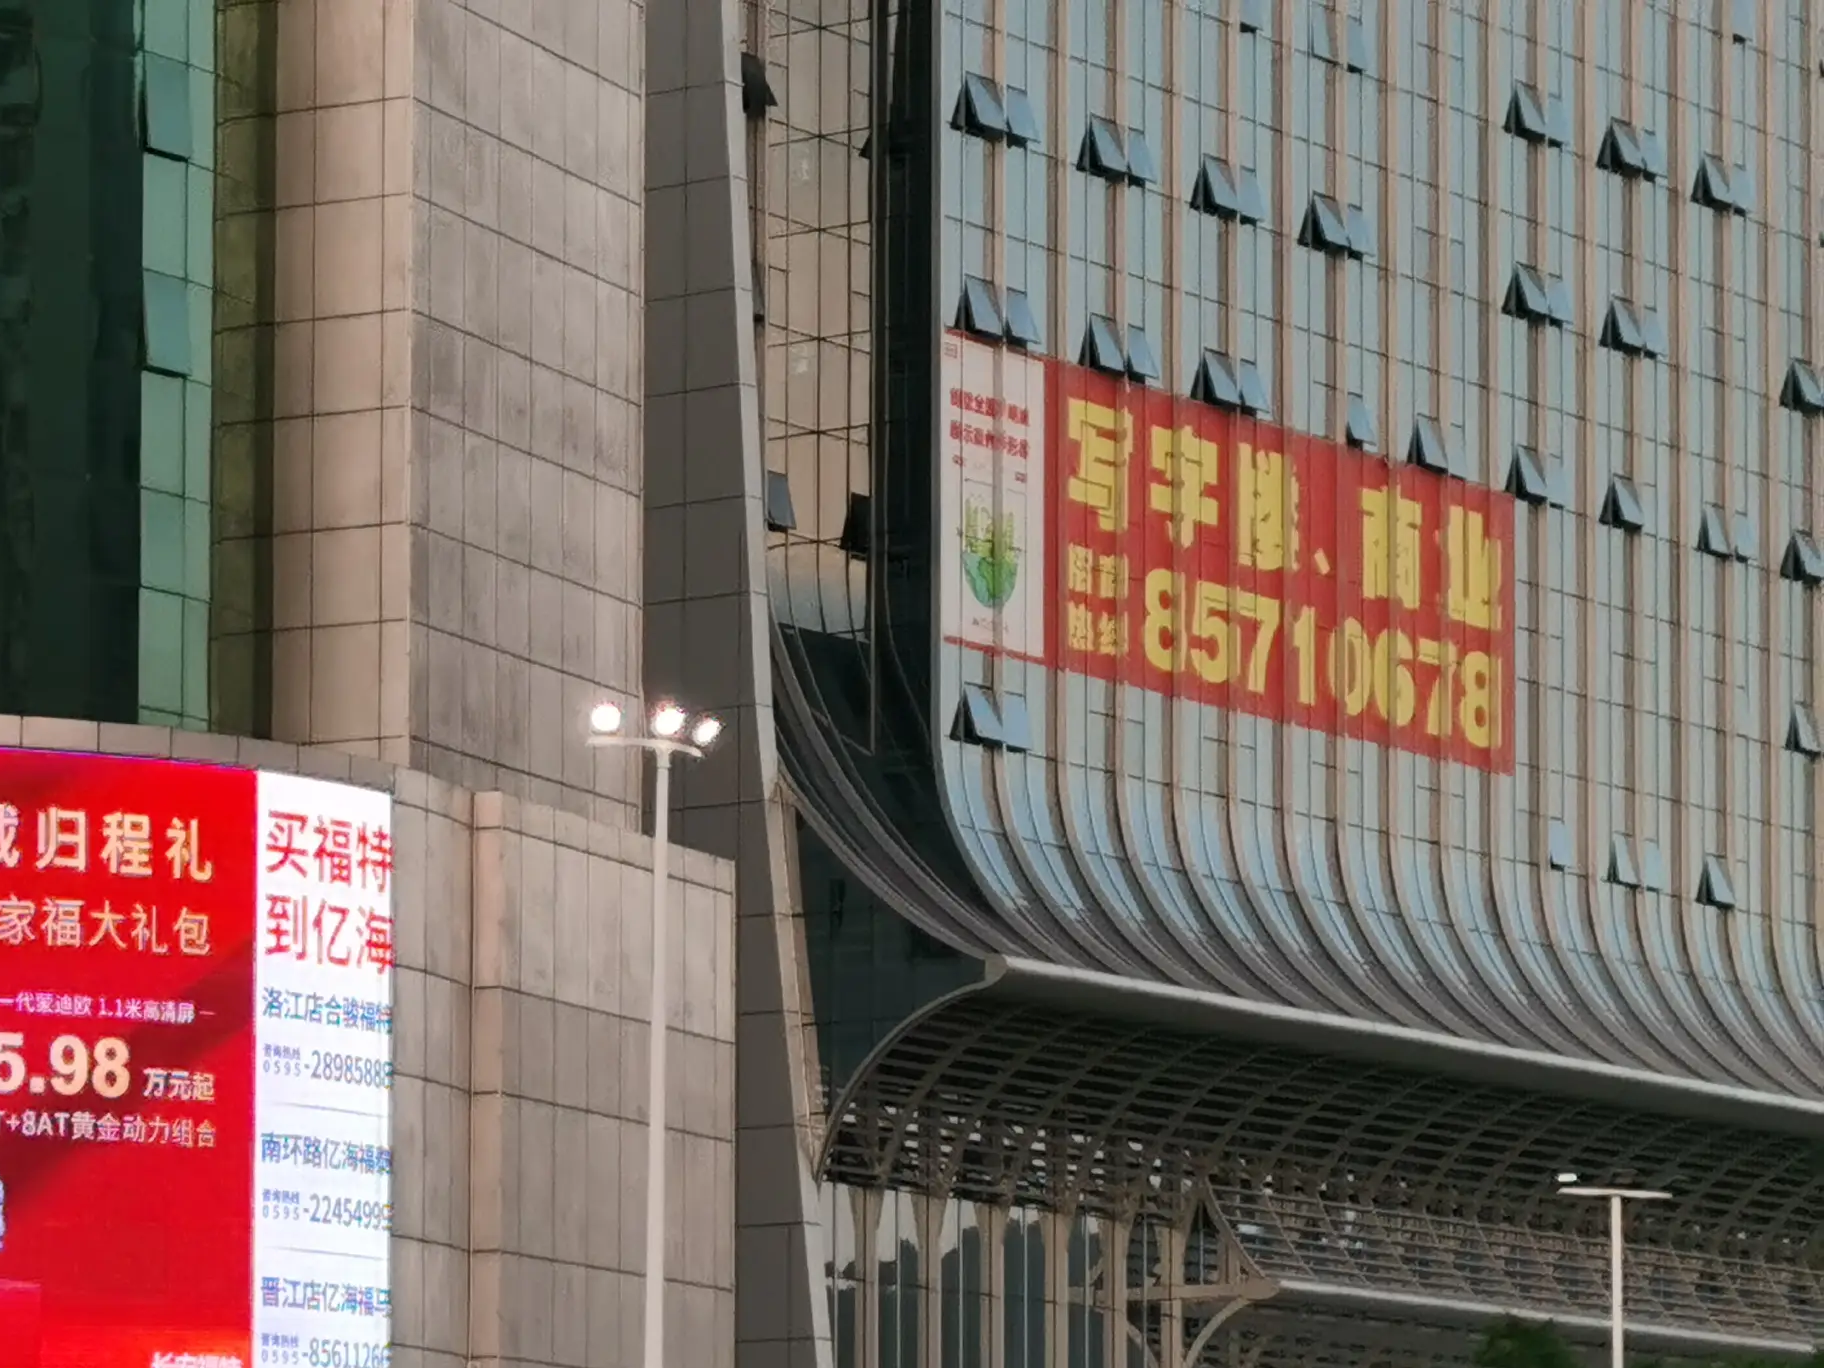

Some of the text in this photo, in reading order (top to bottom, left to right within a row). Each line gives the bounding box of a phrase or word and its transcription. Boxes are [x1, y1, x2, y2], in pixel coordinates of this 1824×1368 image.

[1143, 568, 1503, 750] 85710678
[265, 809, 393, 892] 买福特
[265, 893, 394, 975] 到亿海
[99, 999, 195, 1023] 1.1米高清屏
[143, 1067, 215, 1101] 万元起
